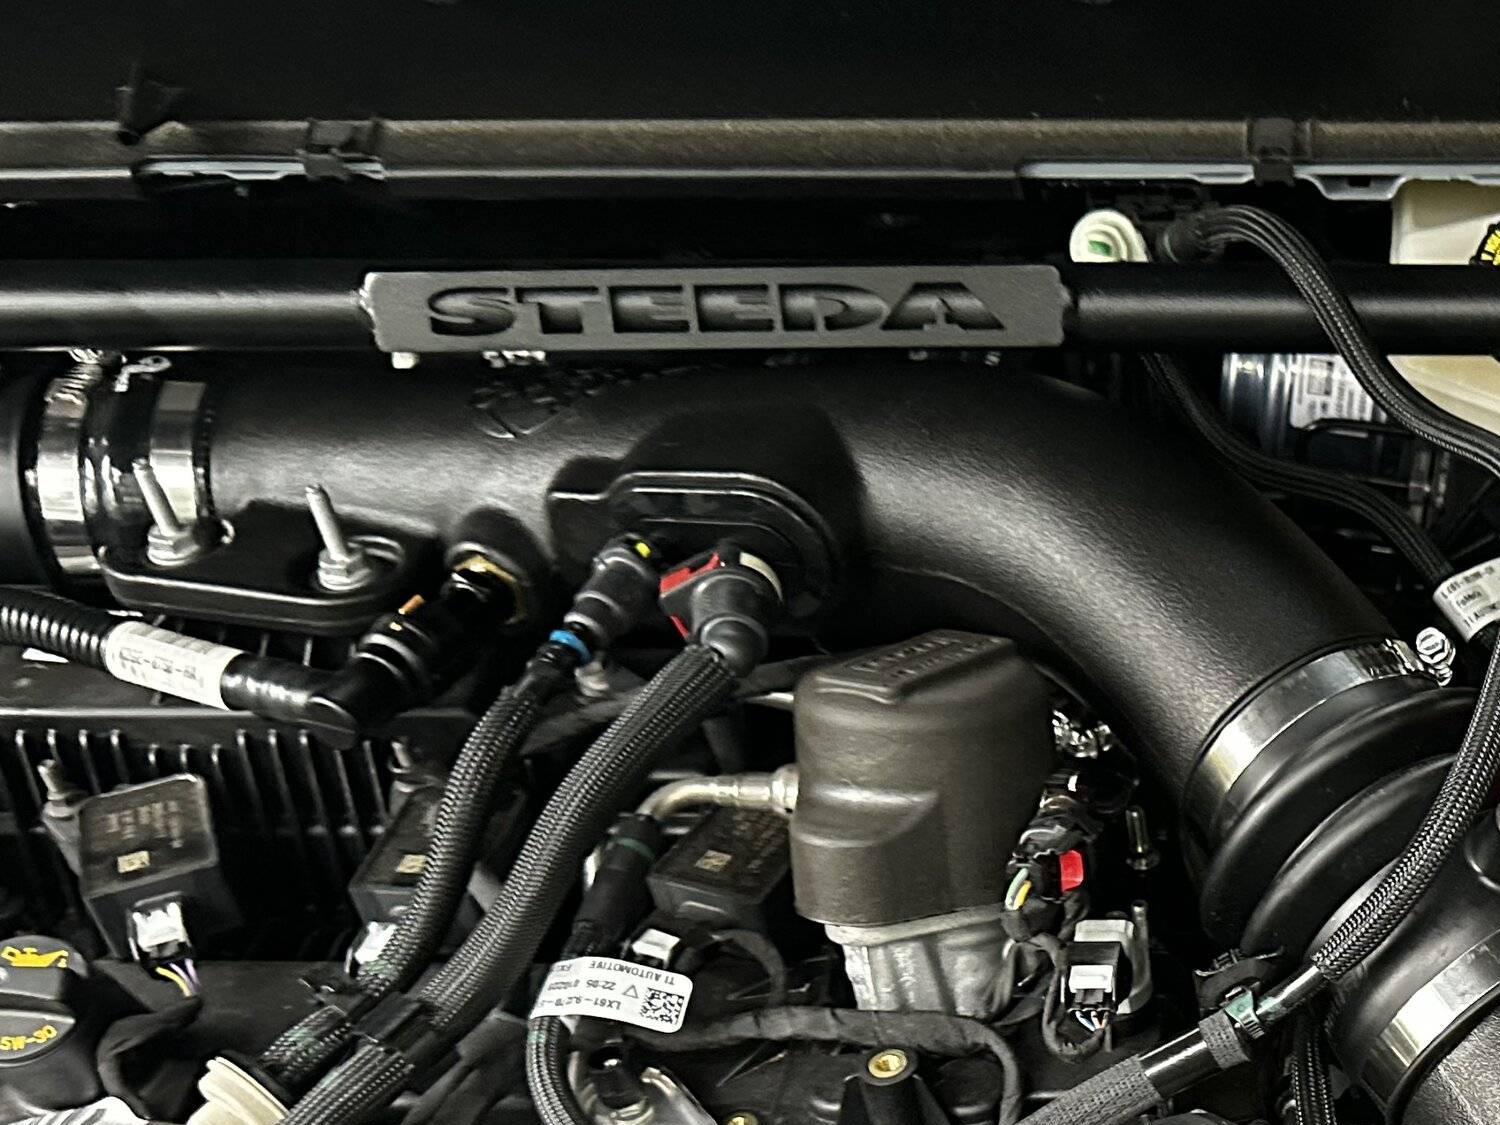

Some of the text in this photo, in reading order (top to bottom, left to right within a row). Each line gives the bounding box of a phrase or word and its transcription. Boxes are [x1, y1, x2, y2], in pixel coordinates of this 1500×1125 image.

[428, 283, 1004, 336] STEEDA
[588, 960, 674, 986] TI AUTOMOTIVE
